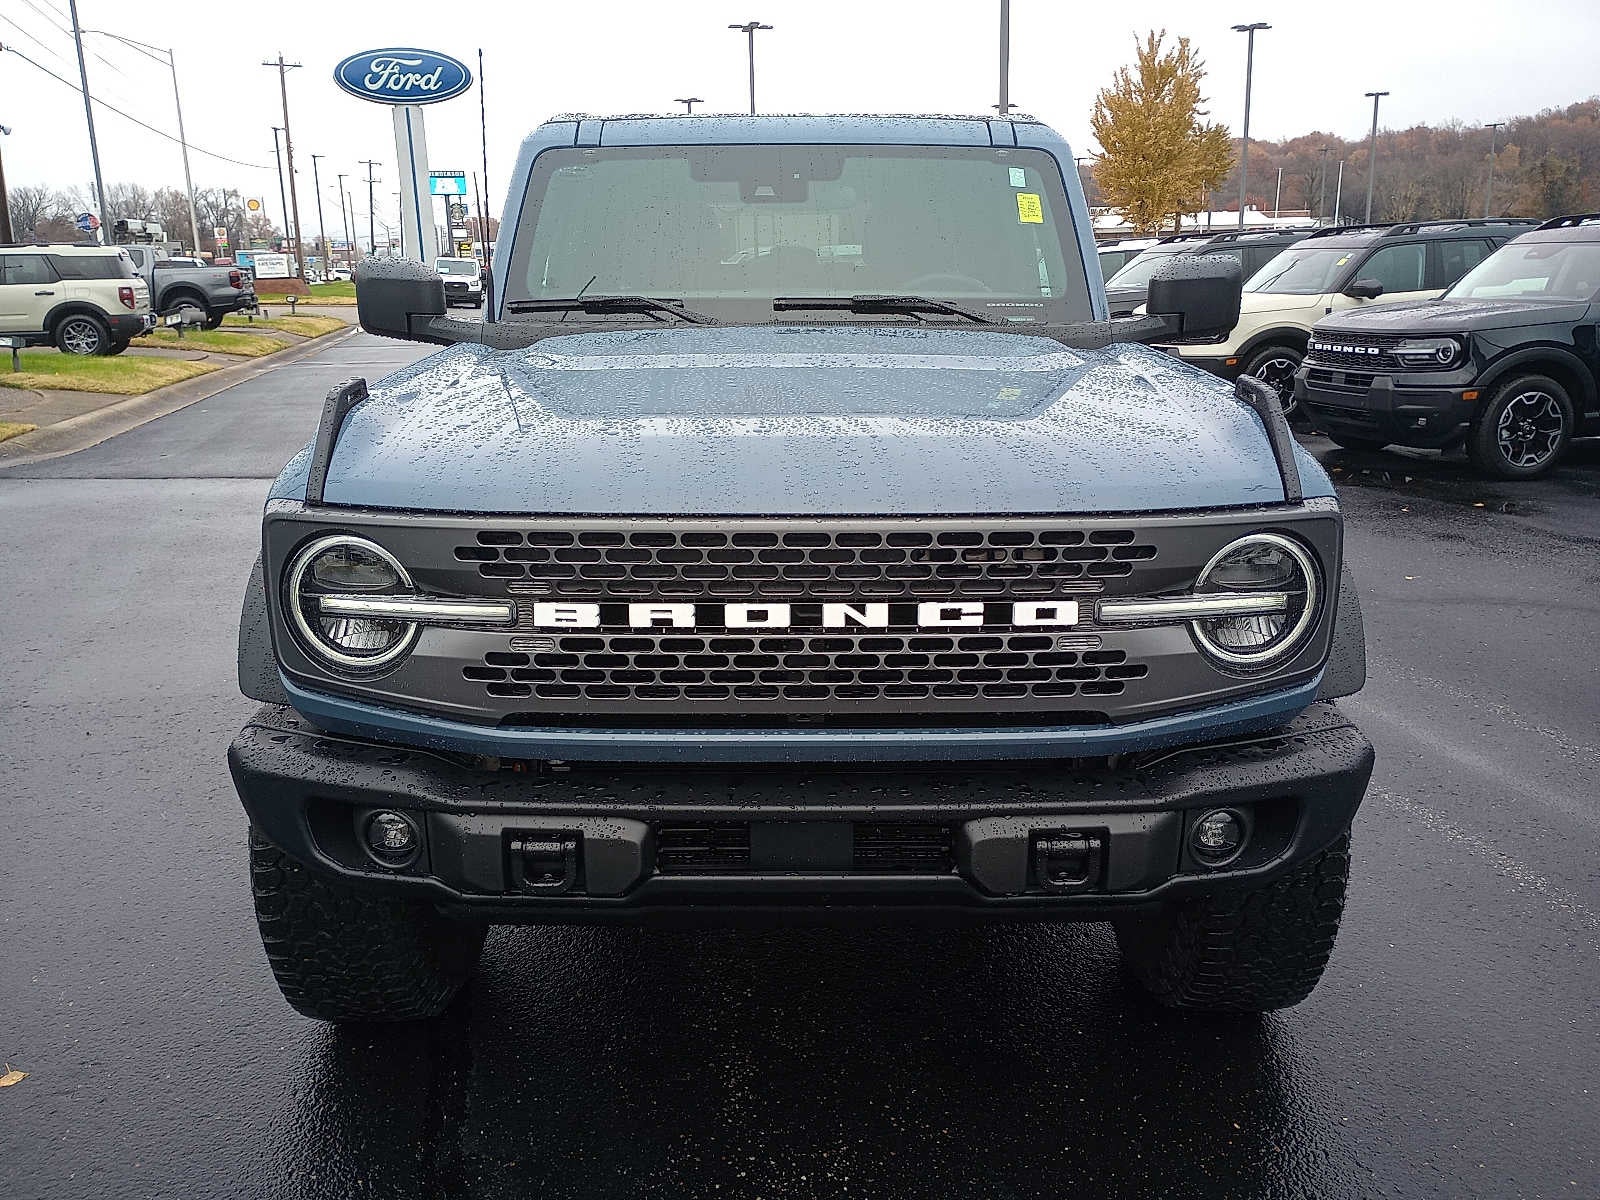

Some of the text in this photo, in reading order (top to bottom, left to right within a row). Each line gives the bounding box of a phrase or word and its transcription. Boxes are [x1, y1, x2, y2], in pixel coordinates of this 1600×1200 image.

[364, 57, 442, 91] Ford
[1314, 343, 1379, 354] BRONCO
[533, 601, 1079, 627] BRONCO
